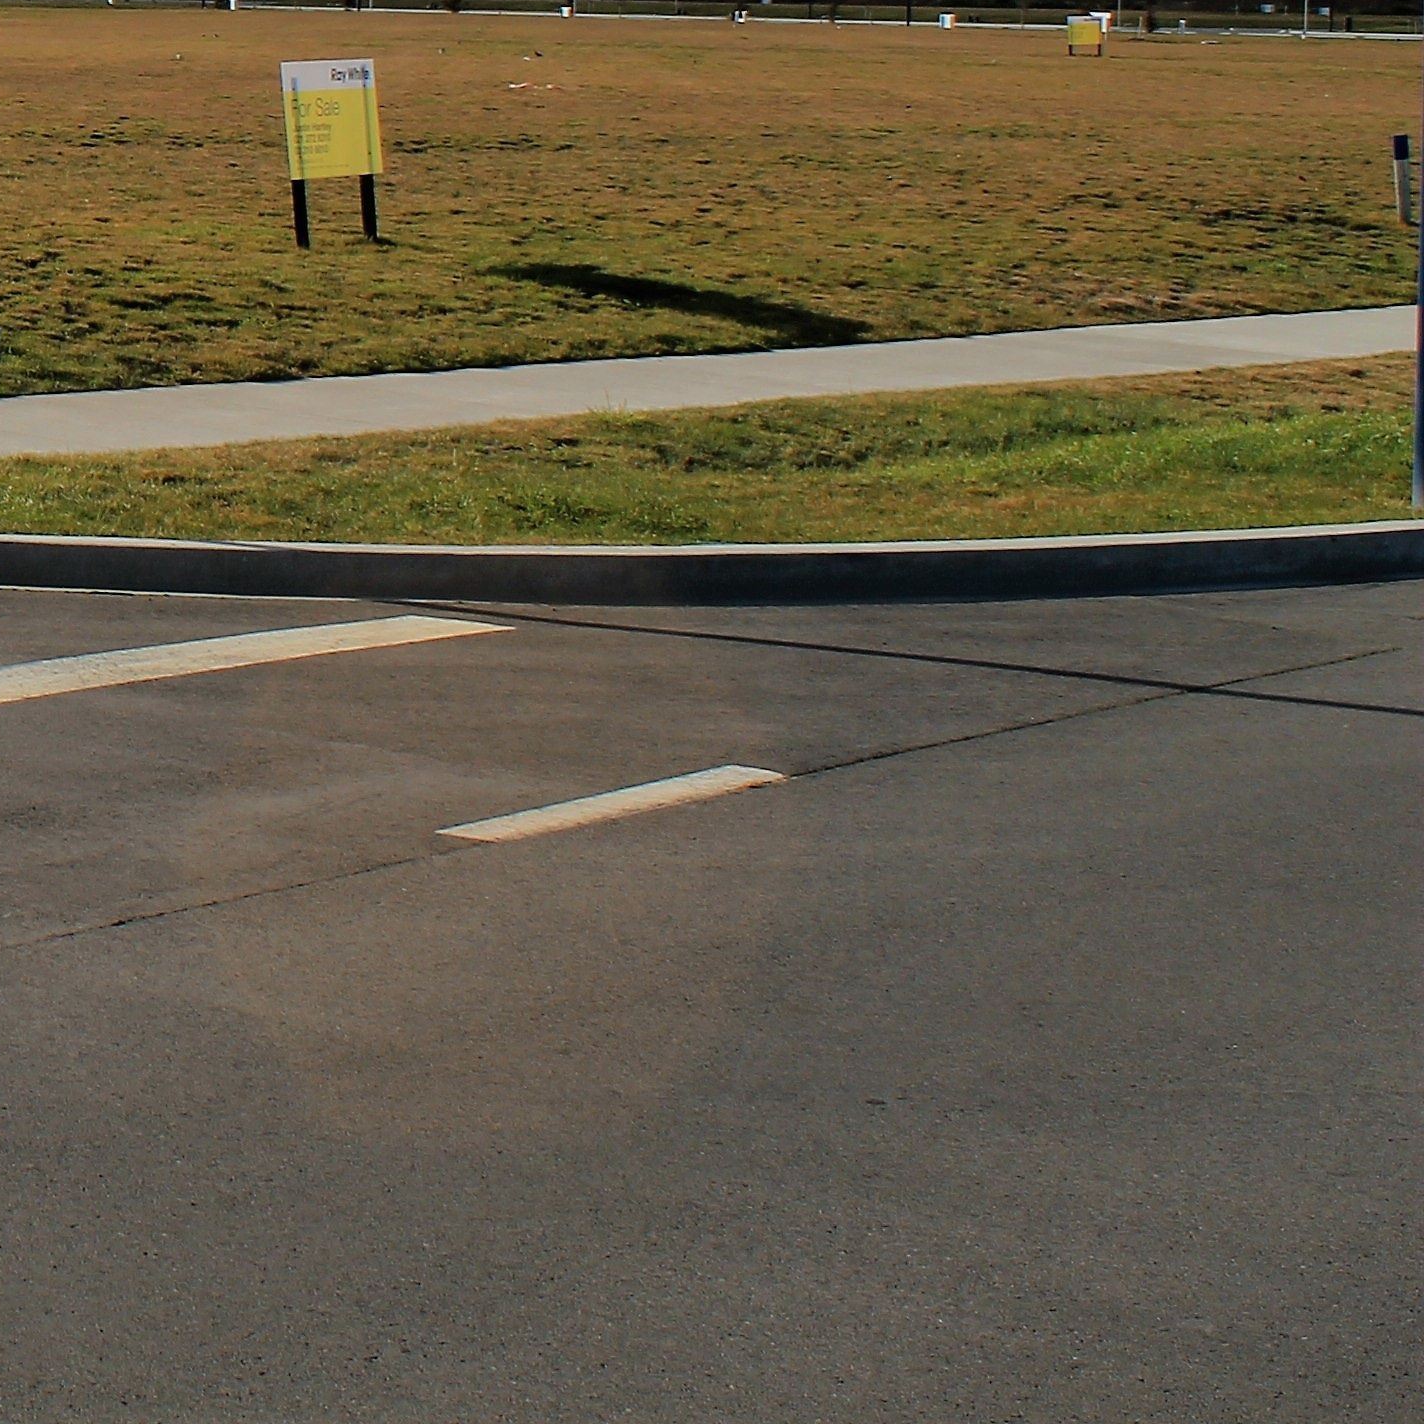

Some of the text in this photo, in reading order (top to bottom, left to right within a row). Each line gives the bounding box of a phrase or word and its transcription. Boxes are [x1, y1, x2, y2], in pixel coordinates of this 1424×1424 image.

[331, 67, 346, 83] Ray
[292, 97, 340, 118] For Sale
